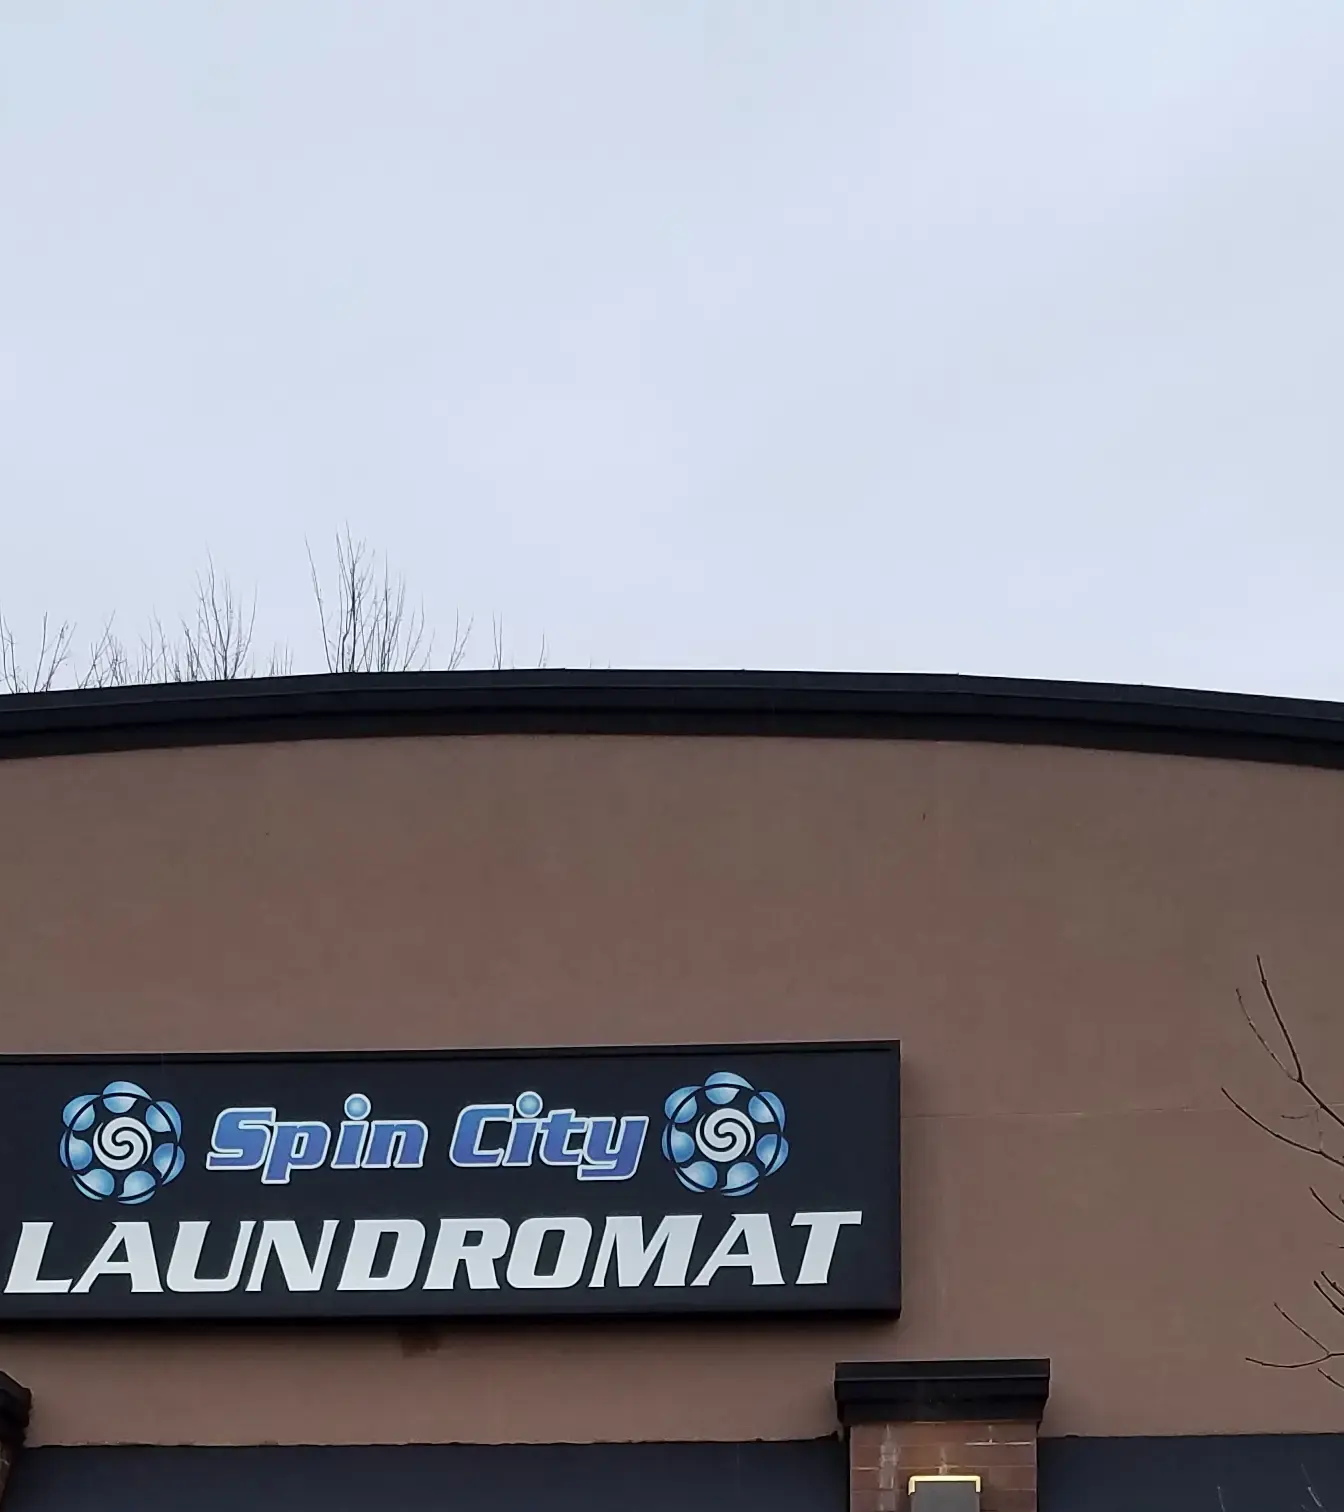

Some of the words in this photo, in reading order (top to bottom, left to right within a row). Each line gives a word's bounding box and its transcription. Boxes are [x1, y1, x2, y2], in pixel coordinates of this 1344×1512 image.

[205, 1093, 428, 1185] Spin
[449, 1091, 649, 1181] City
[3, 1211, 862, 1294] LAUNDROMAT
